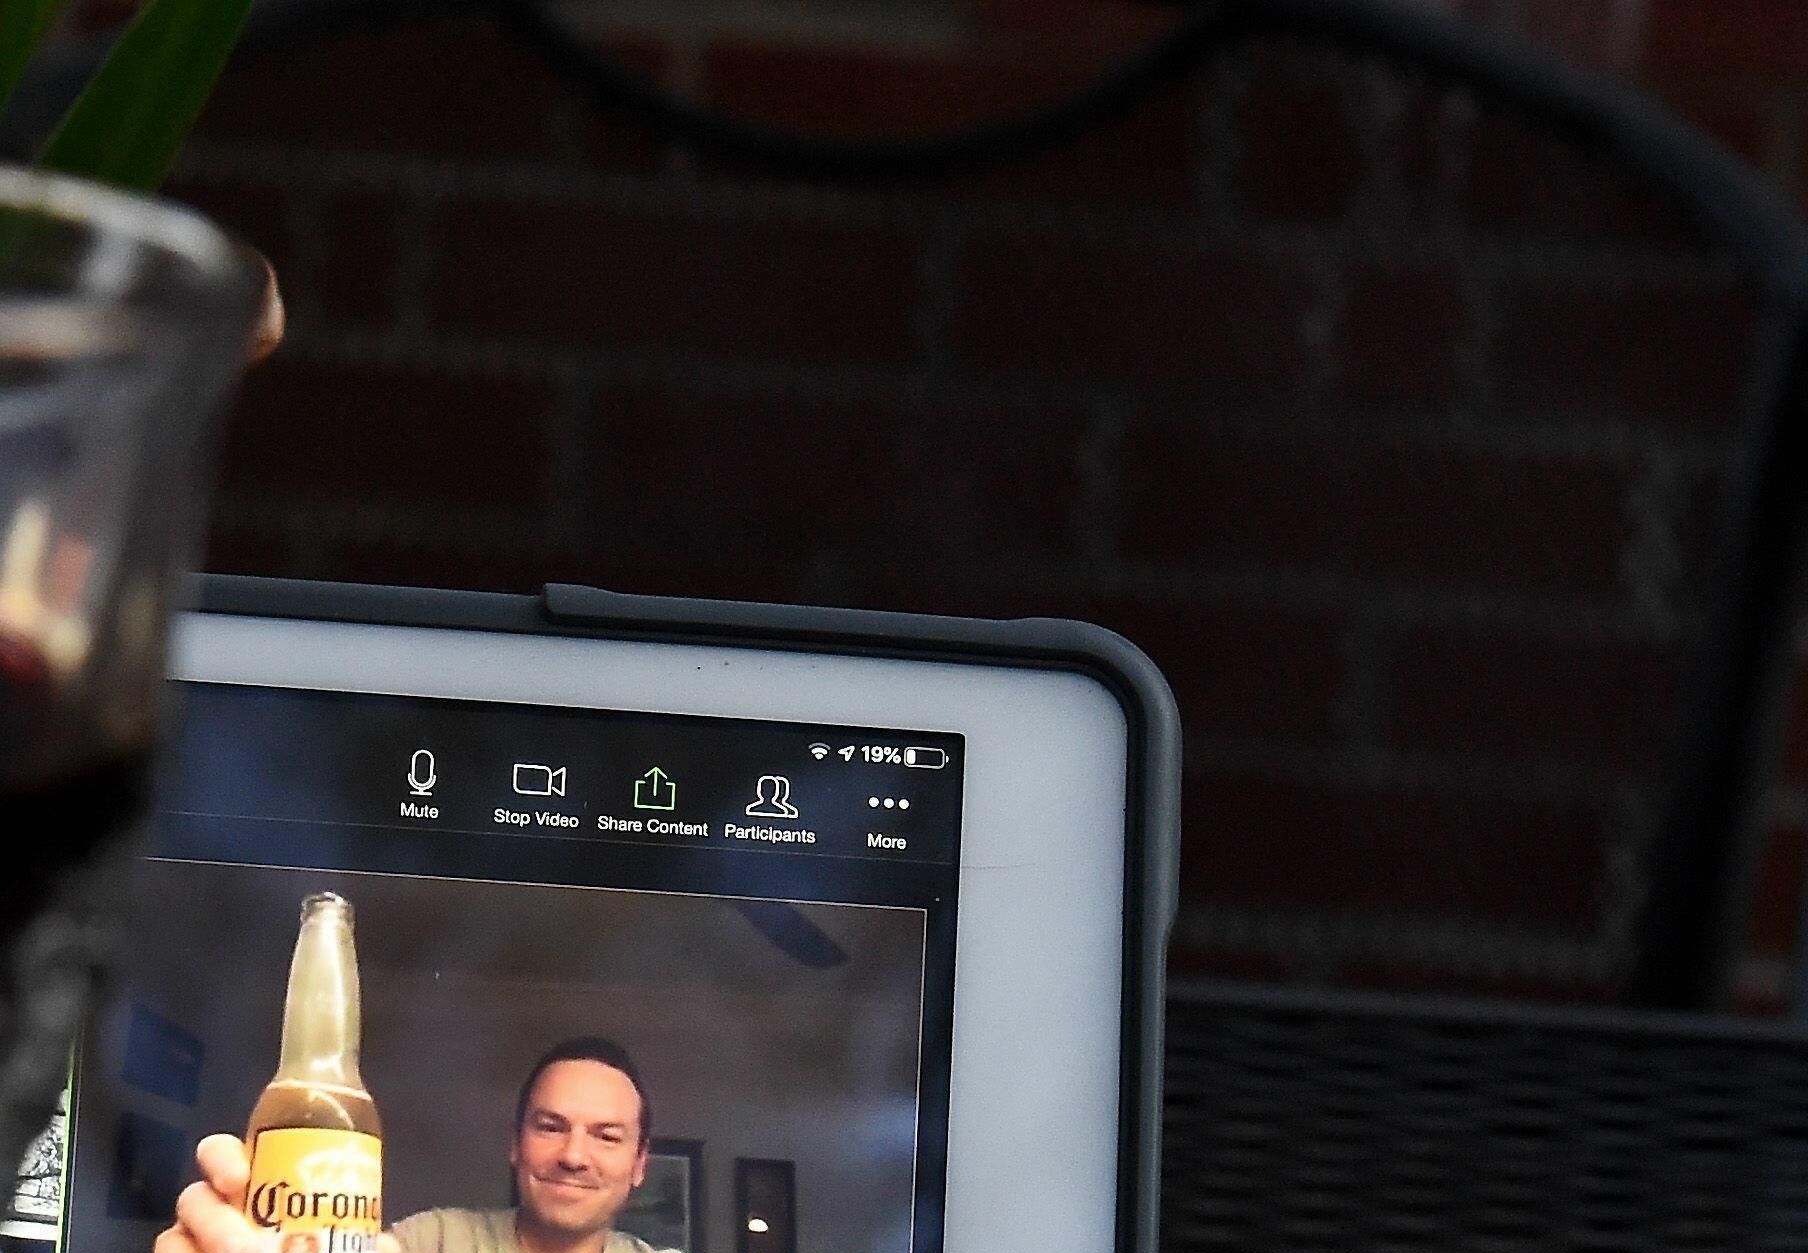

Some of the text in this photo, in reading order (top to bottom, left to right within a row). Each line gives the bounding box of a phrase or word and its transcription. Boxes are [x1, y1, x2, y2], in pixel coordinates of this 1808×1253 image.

[861, 745, 902, 764] 19%
[400, 802, 439, 819] Mute
[494, 808, 580, 828] Stop Video
[597, 815, 709, 837] Share Content
[724, 823, 817, 844] Participants
[867, 832, 907, 850] More
